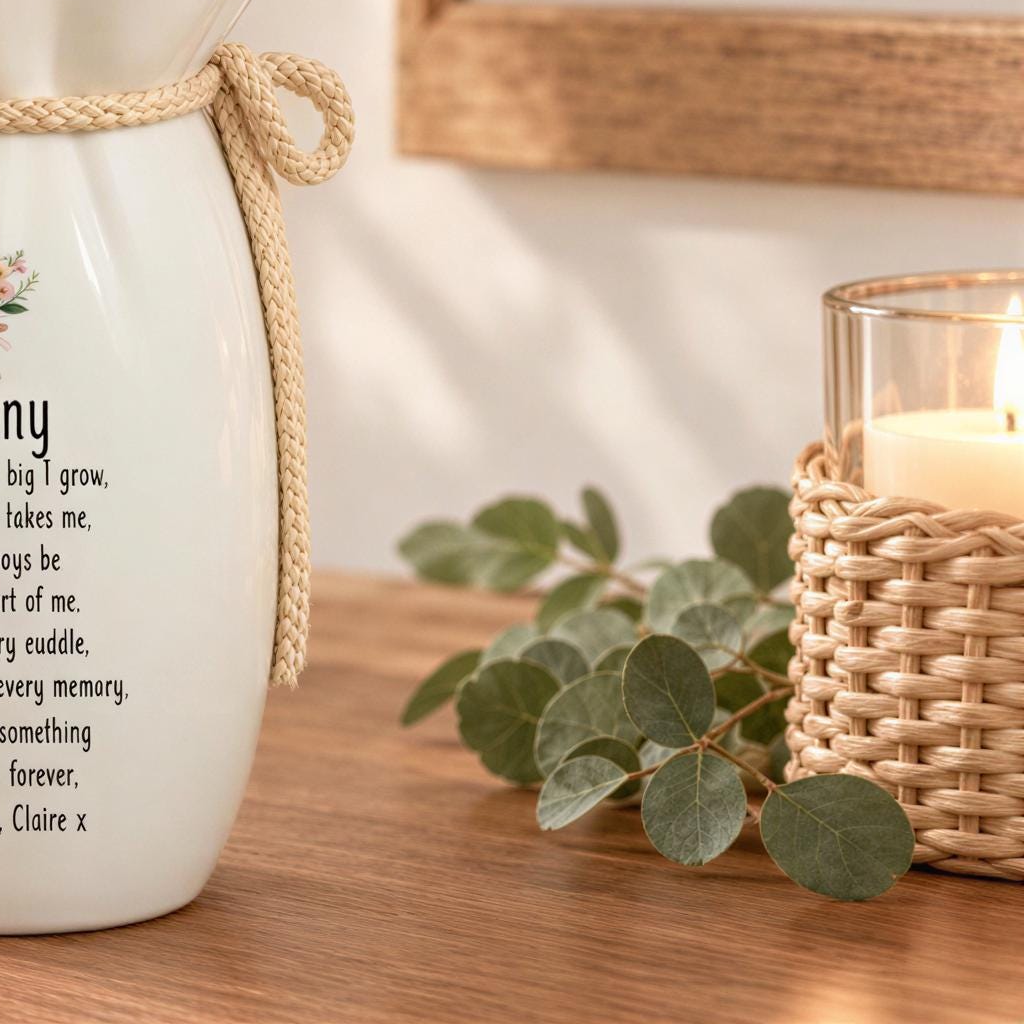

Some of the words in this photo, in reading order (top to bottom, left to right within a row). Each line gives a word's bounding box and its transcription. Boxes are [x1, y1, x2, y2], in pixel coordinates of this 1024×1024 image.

[7, 459, 35, 496] big
[59, 468, 109, 496] grow,
[6, 501, 54, 530] takes
[62, 510, 92, 532] me,
[40, 543, 61, 572] be
[25, 585, 44, 613] of
[51, 594, 81, 614] me.
[8, 758, 79, 790] forever,
[12, 803, 67, 833] Claire
[76, 813, 87, 832] x
